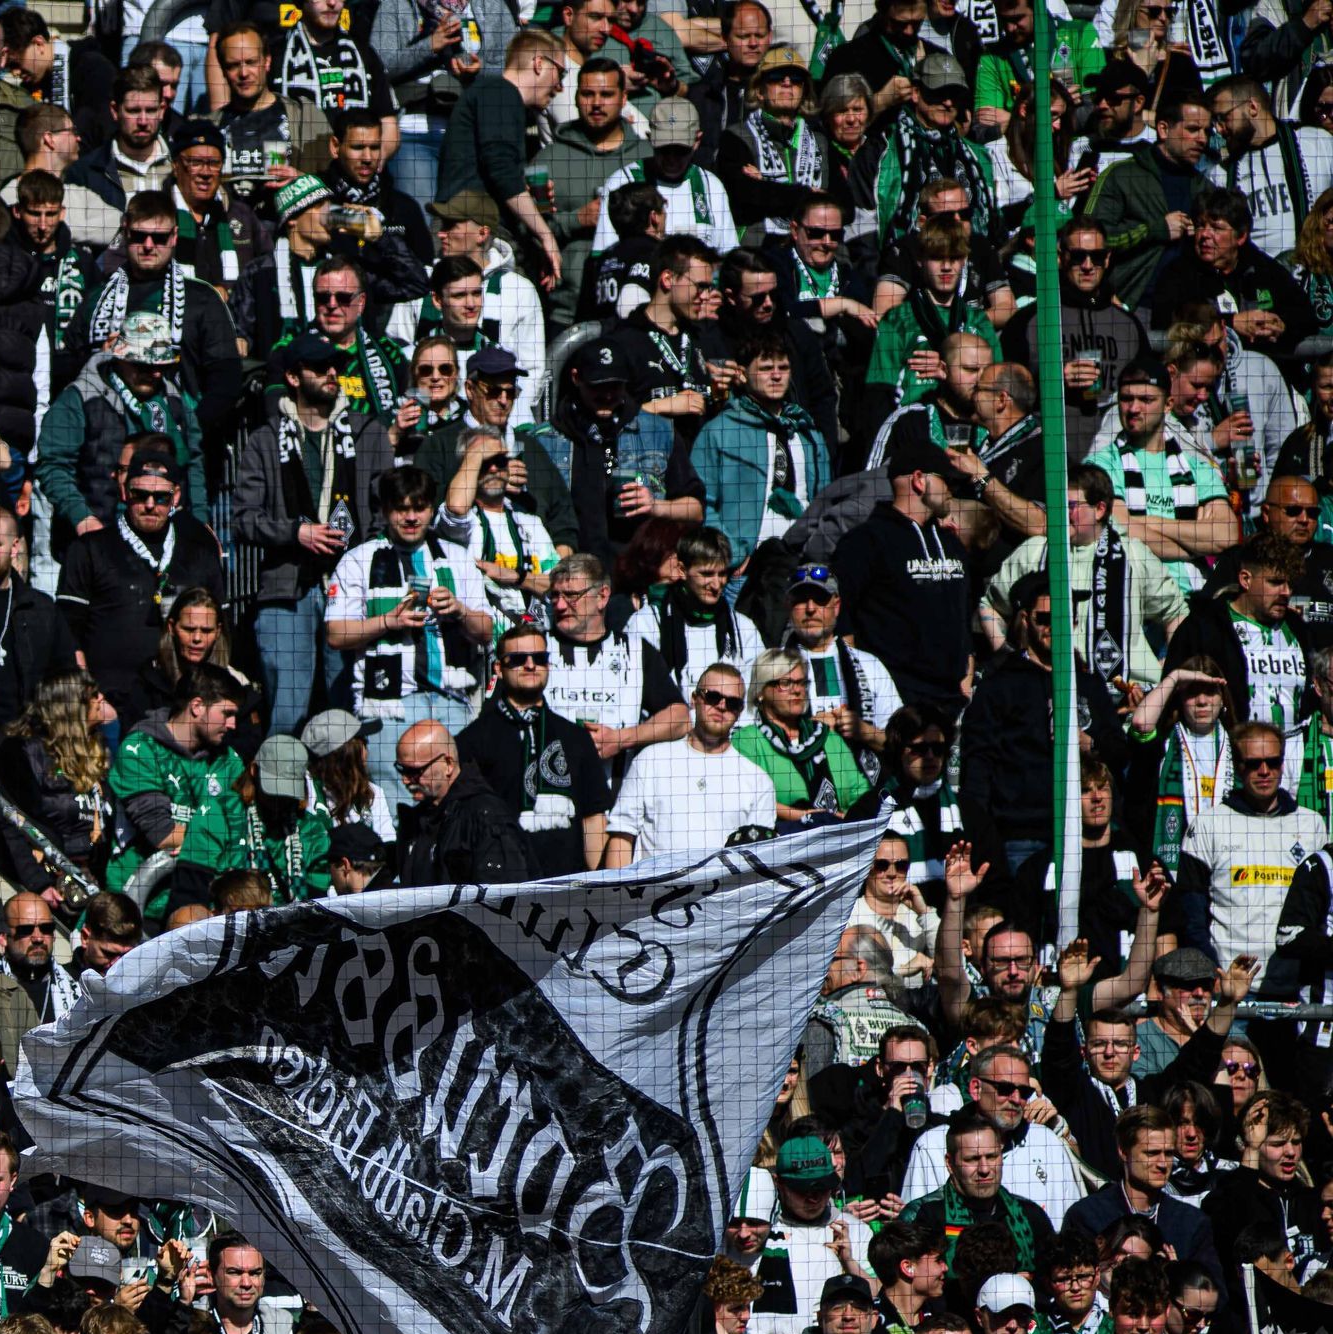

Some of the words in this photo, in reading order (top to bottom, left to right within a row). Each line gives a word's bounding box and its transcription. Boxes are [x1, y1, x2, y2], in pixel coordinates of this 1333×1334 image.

[599, 348, 614, 365] 3
[1250, 650, 1307, 677] iebels
[549, 687, 616, 704] flatex
